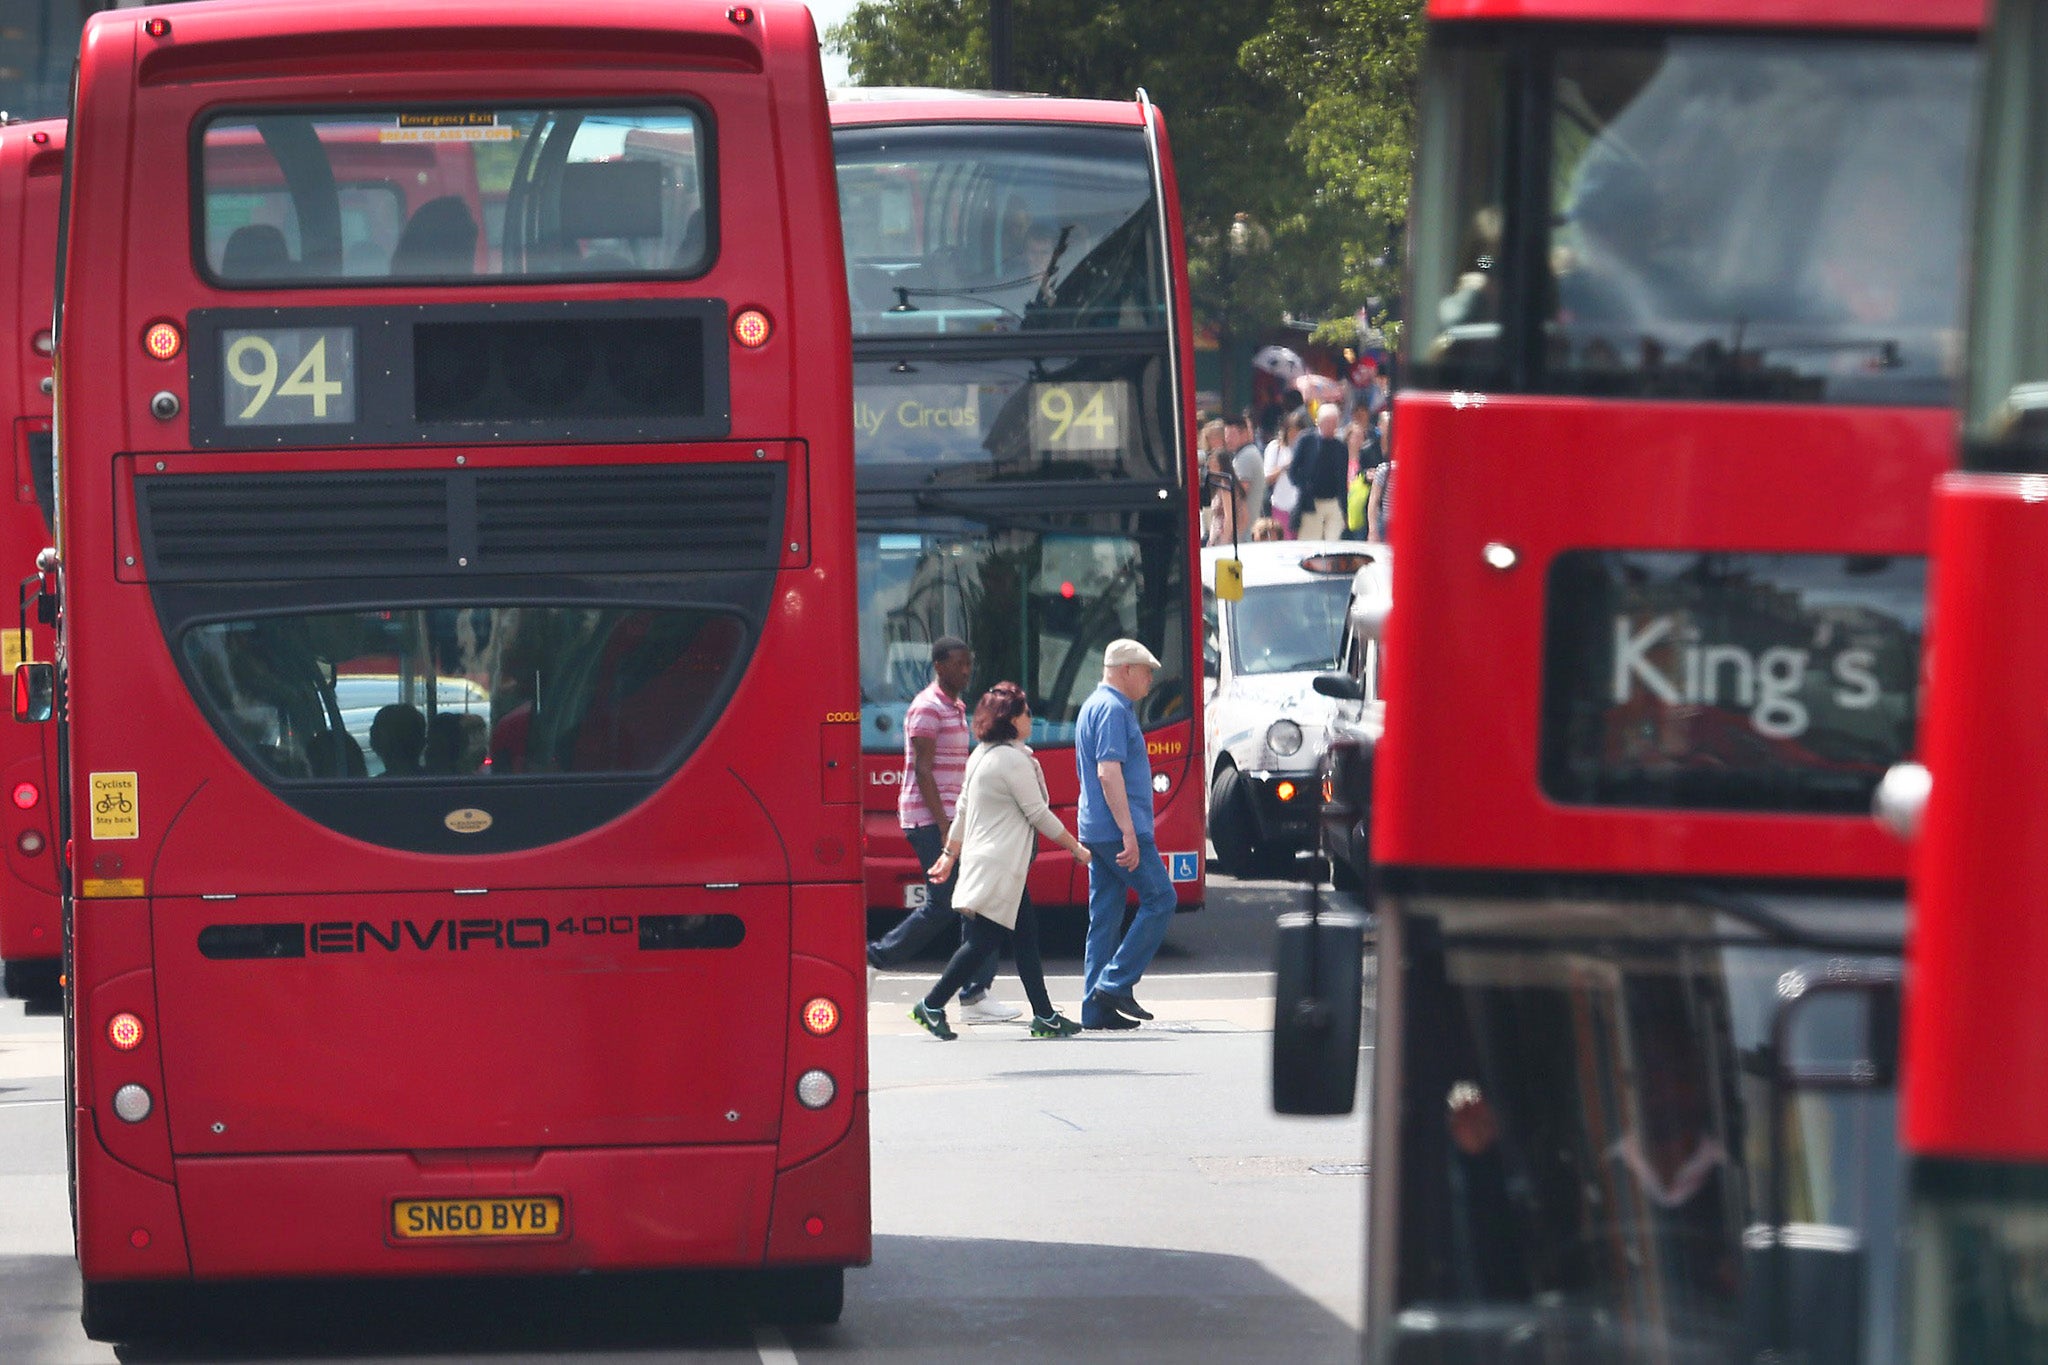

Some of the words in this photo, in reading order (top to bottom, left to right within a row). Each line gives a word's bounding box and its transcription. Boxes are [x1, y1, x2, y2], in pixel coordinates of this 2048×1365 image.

[401, 113, 465, 125] Emergency
[468, 112, 492, 123] Exit
[227, 335, 342, 418] 94
[898, 400, 977, 428] Circus
[1041, 387, 1114, 442] 94
[1614, 612, 1881, 738] King's
[95, 780, 132, 789] Cyclists
[96, 816, 112, 824] Stay
[310, 917, 549, 953] ENVIRO
[555, 916, 634, 935] 400
[408, 1204, 482, 1231] SN60
[492, 1203, 546, 1229] BYB
